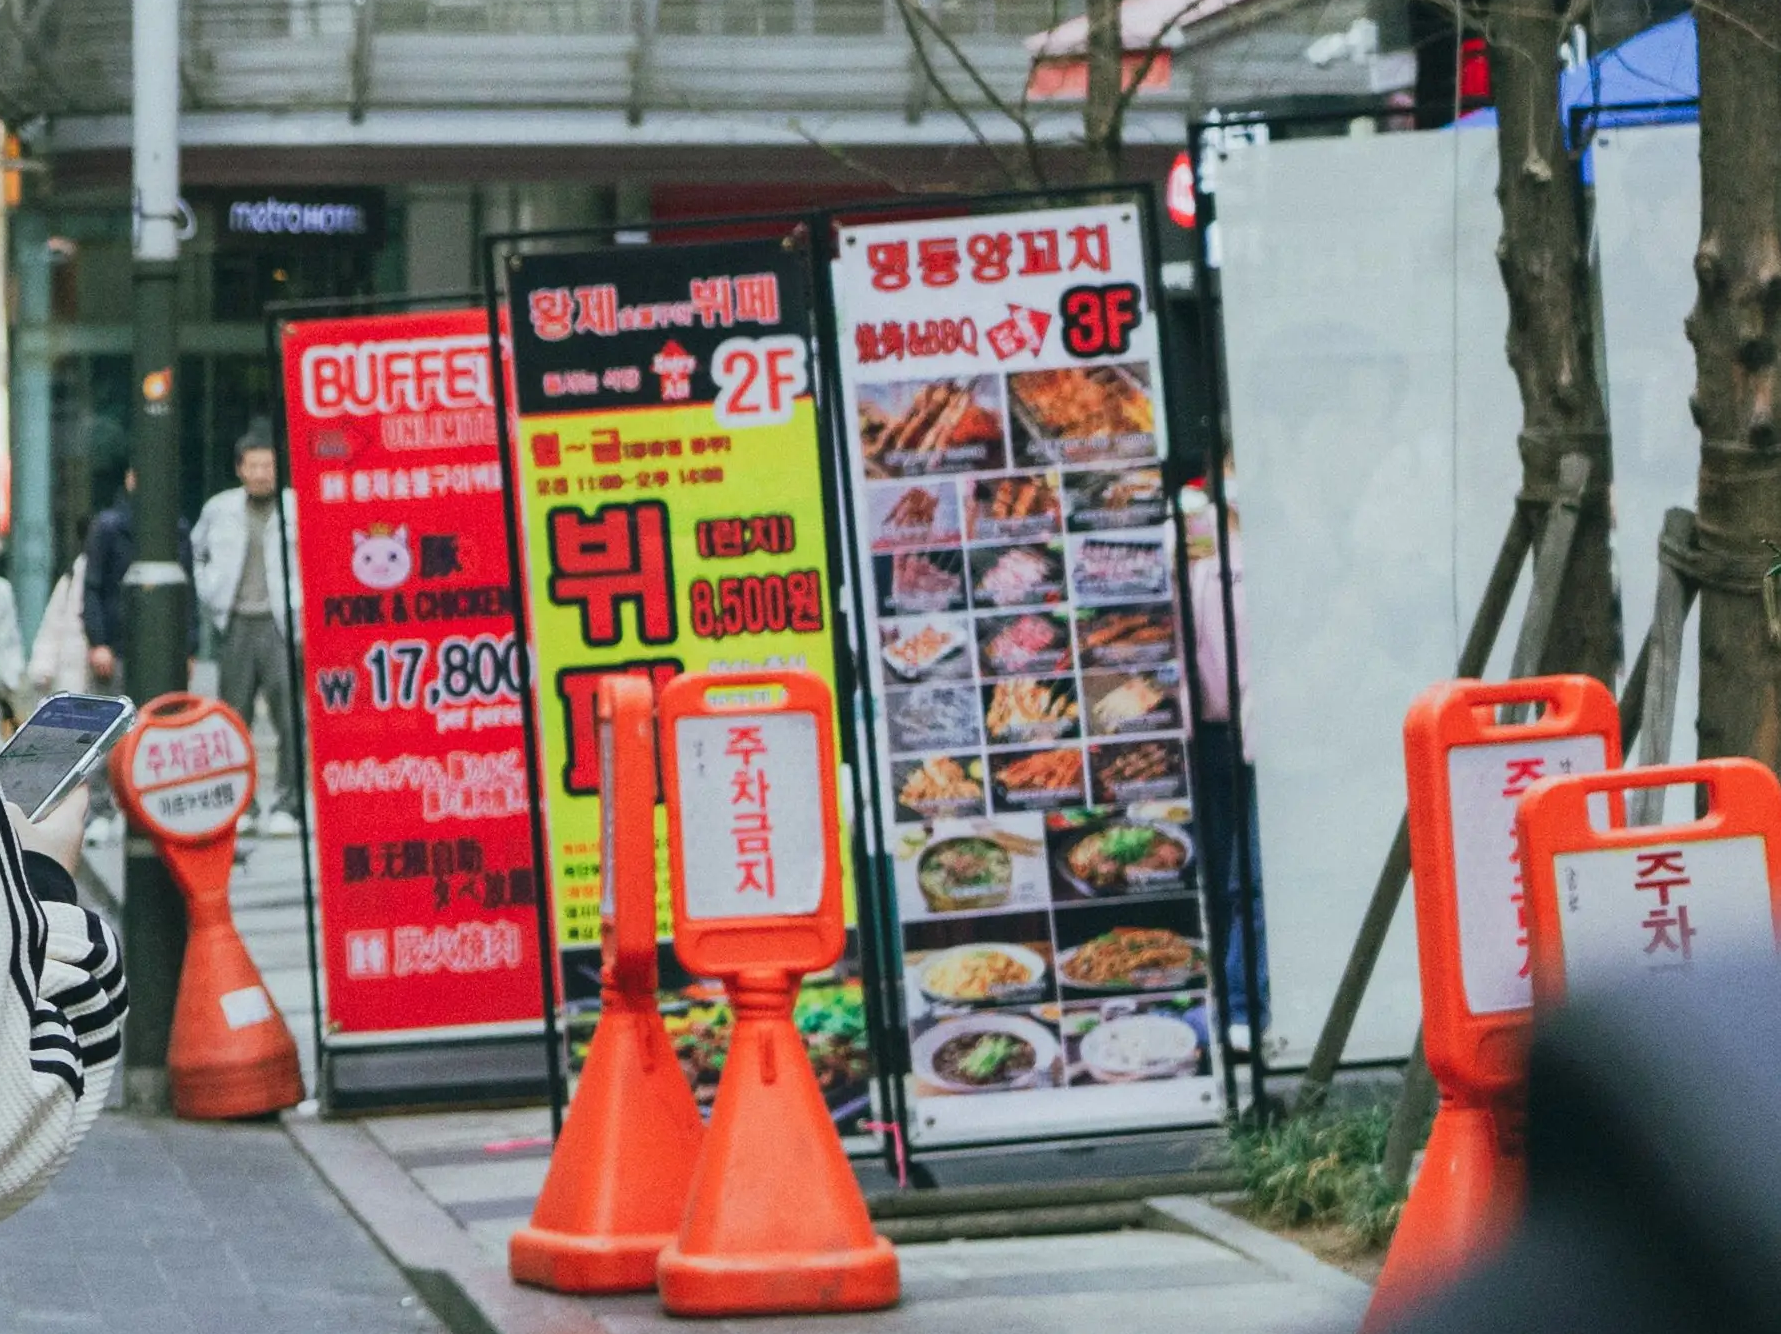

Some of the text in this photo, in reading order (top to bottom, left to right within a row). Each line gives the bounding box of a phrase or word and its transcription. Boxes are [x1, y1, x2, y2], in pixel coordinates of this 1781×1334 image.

[867, 224, 1112, 292] 명동양꼬치
[1061, 283, 1141, 358] 3F
[722, 347, 797, 415] 2F
[691, 569, 823, 639] 8,500원
[147, 729, 233, 779] 주차금지
[724, 725, 776, 899] 주차금지
[1632, 850, 1697, 970] 주차
